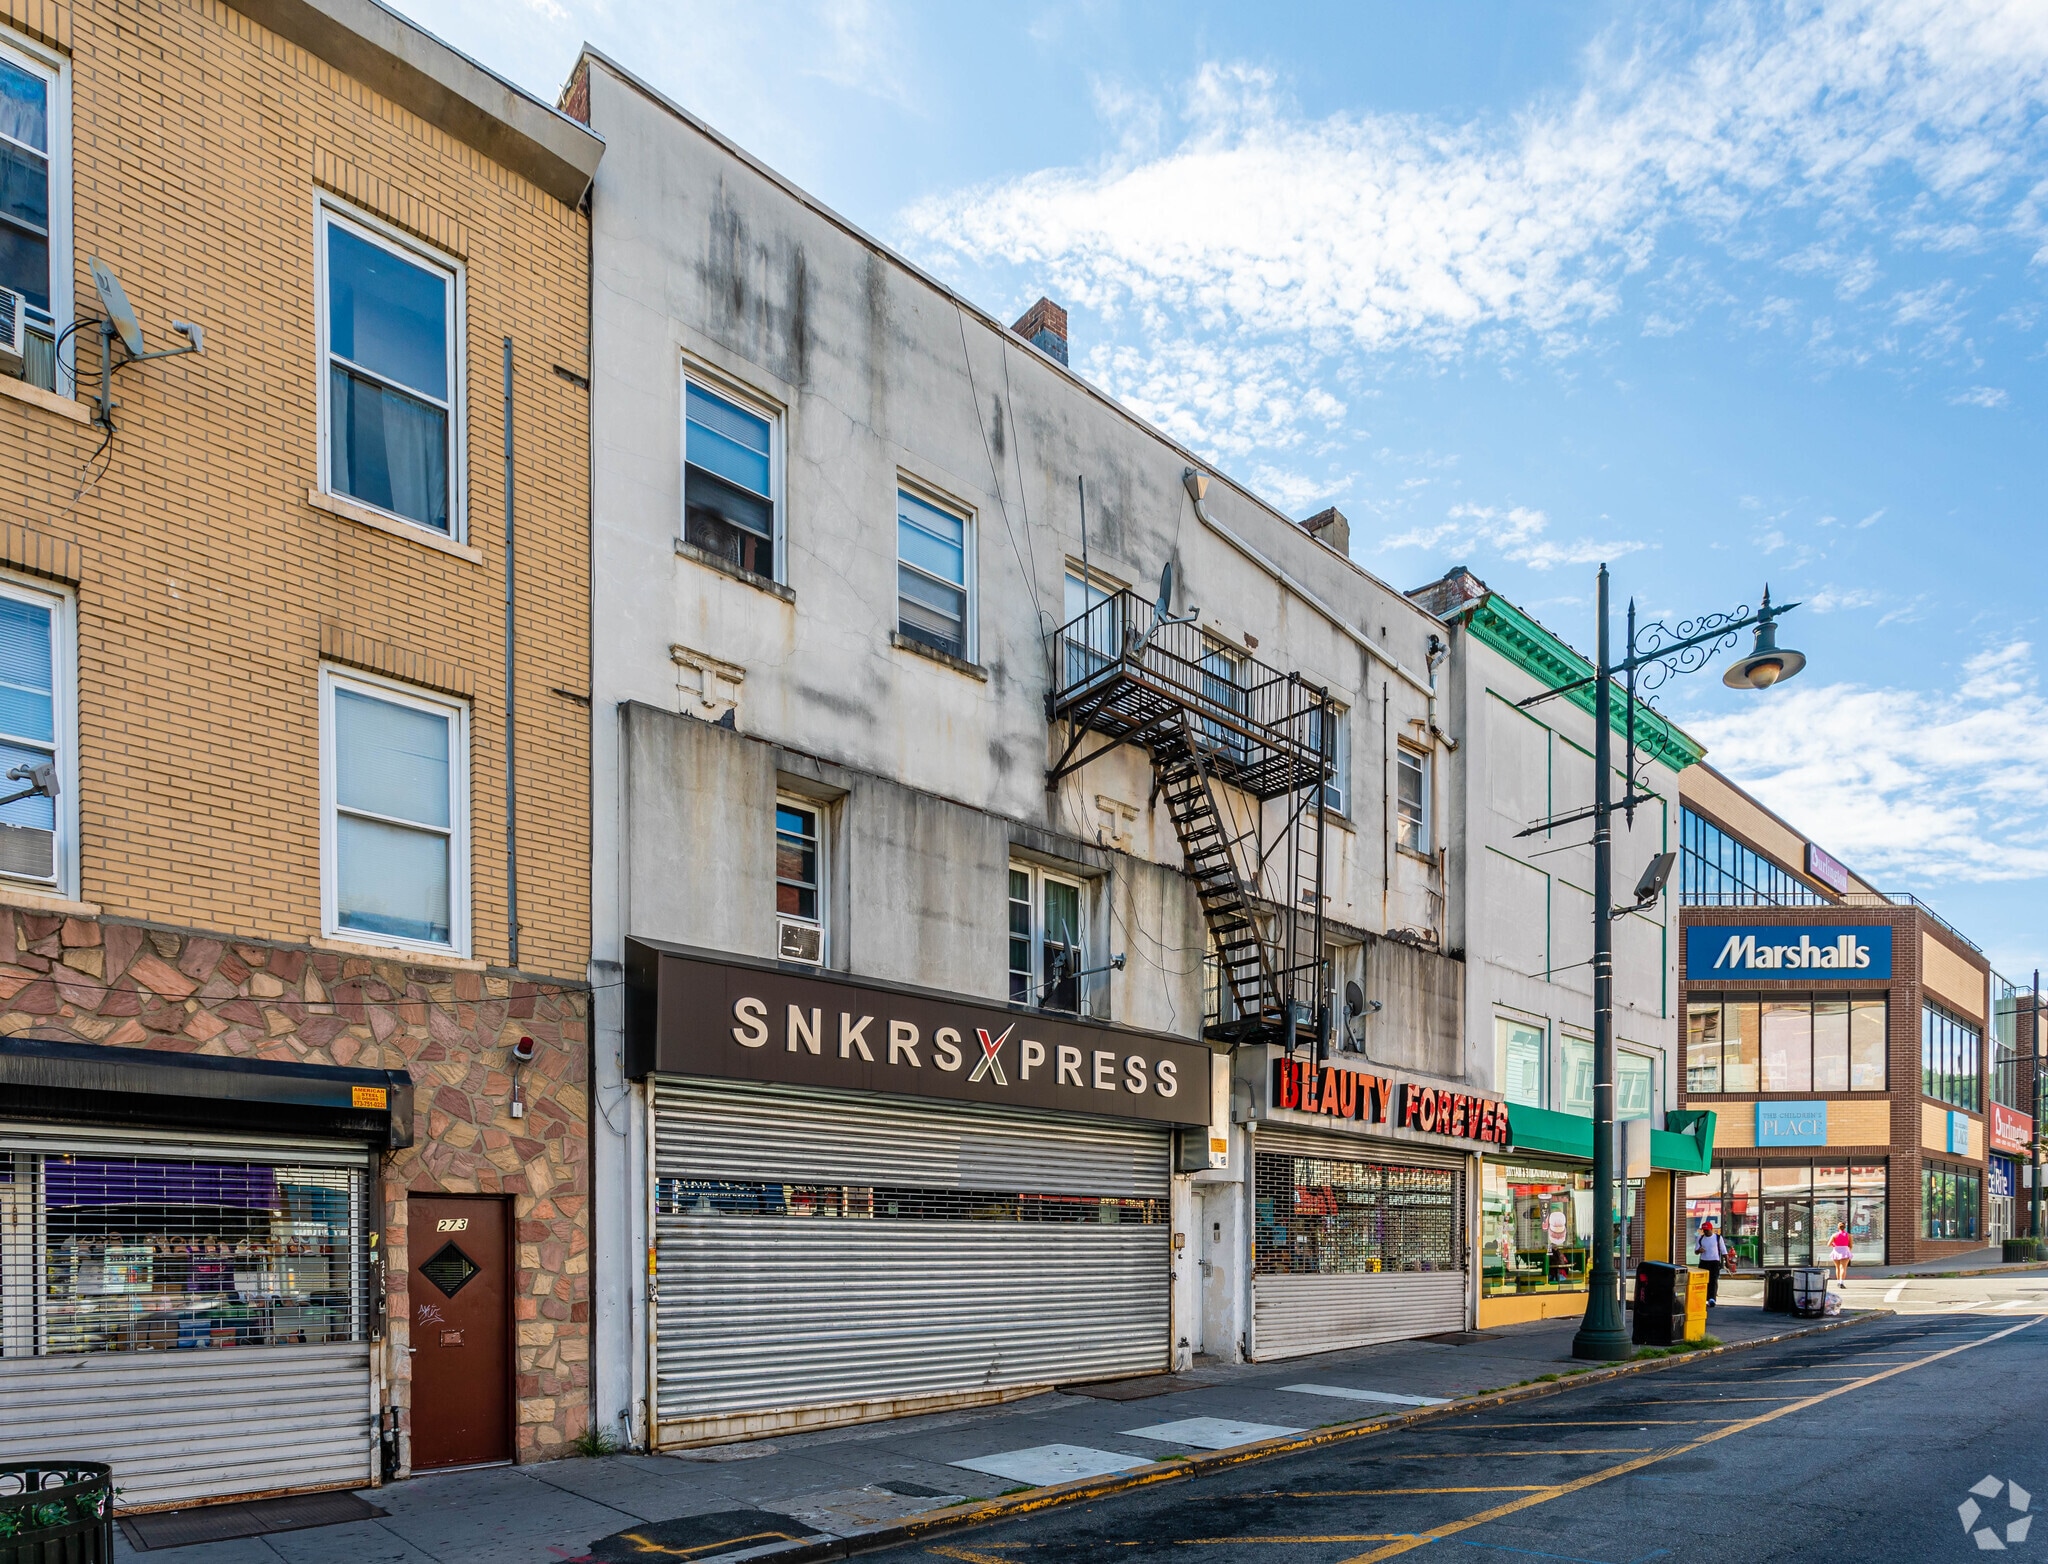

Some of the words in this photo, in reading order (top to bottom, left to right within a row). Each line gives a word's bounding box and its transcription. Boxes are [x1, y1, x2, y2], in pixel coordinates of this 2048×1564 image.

[1713, 934, 1870, 968] Marshalls
[1273, 1057, 1393, 1124] BEAUTY
[1399, 1083, 1509, 1144] FOREVER
[1762, 1119, 1823, 1136] PLACE
[438, 1219, 467, 1231] 273
